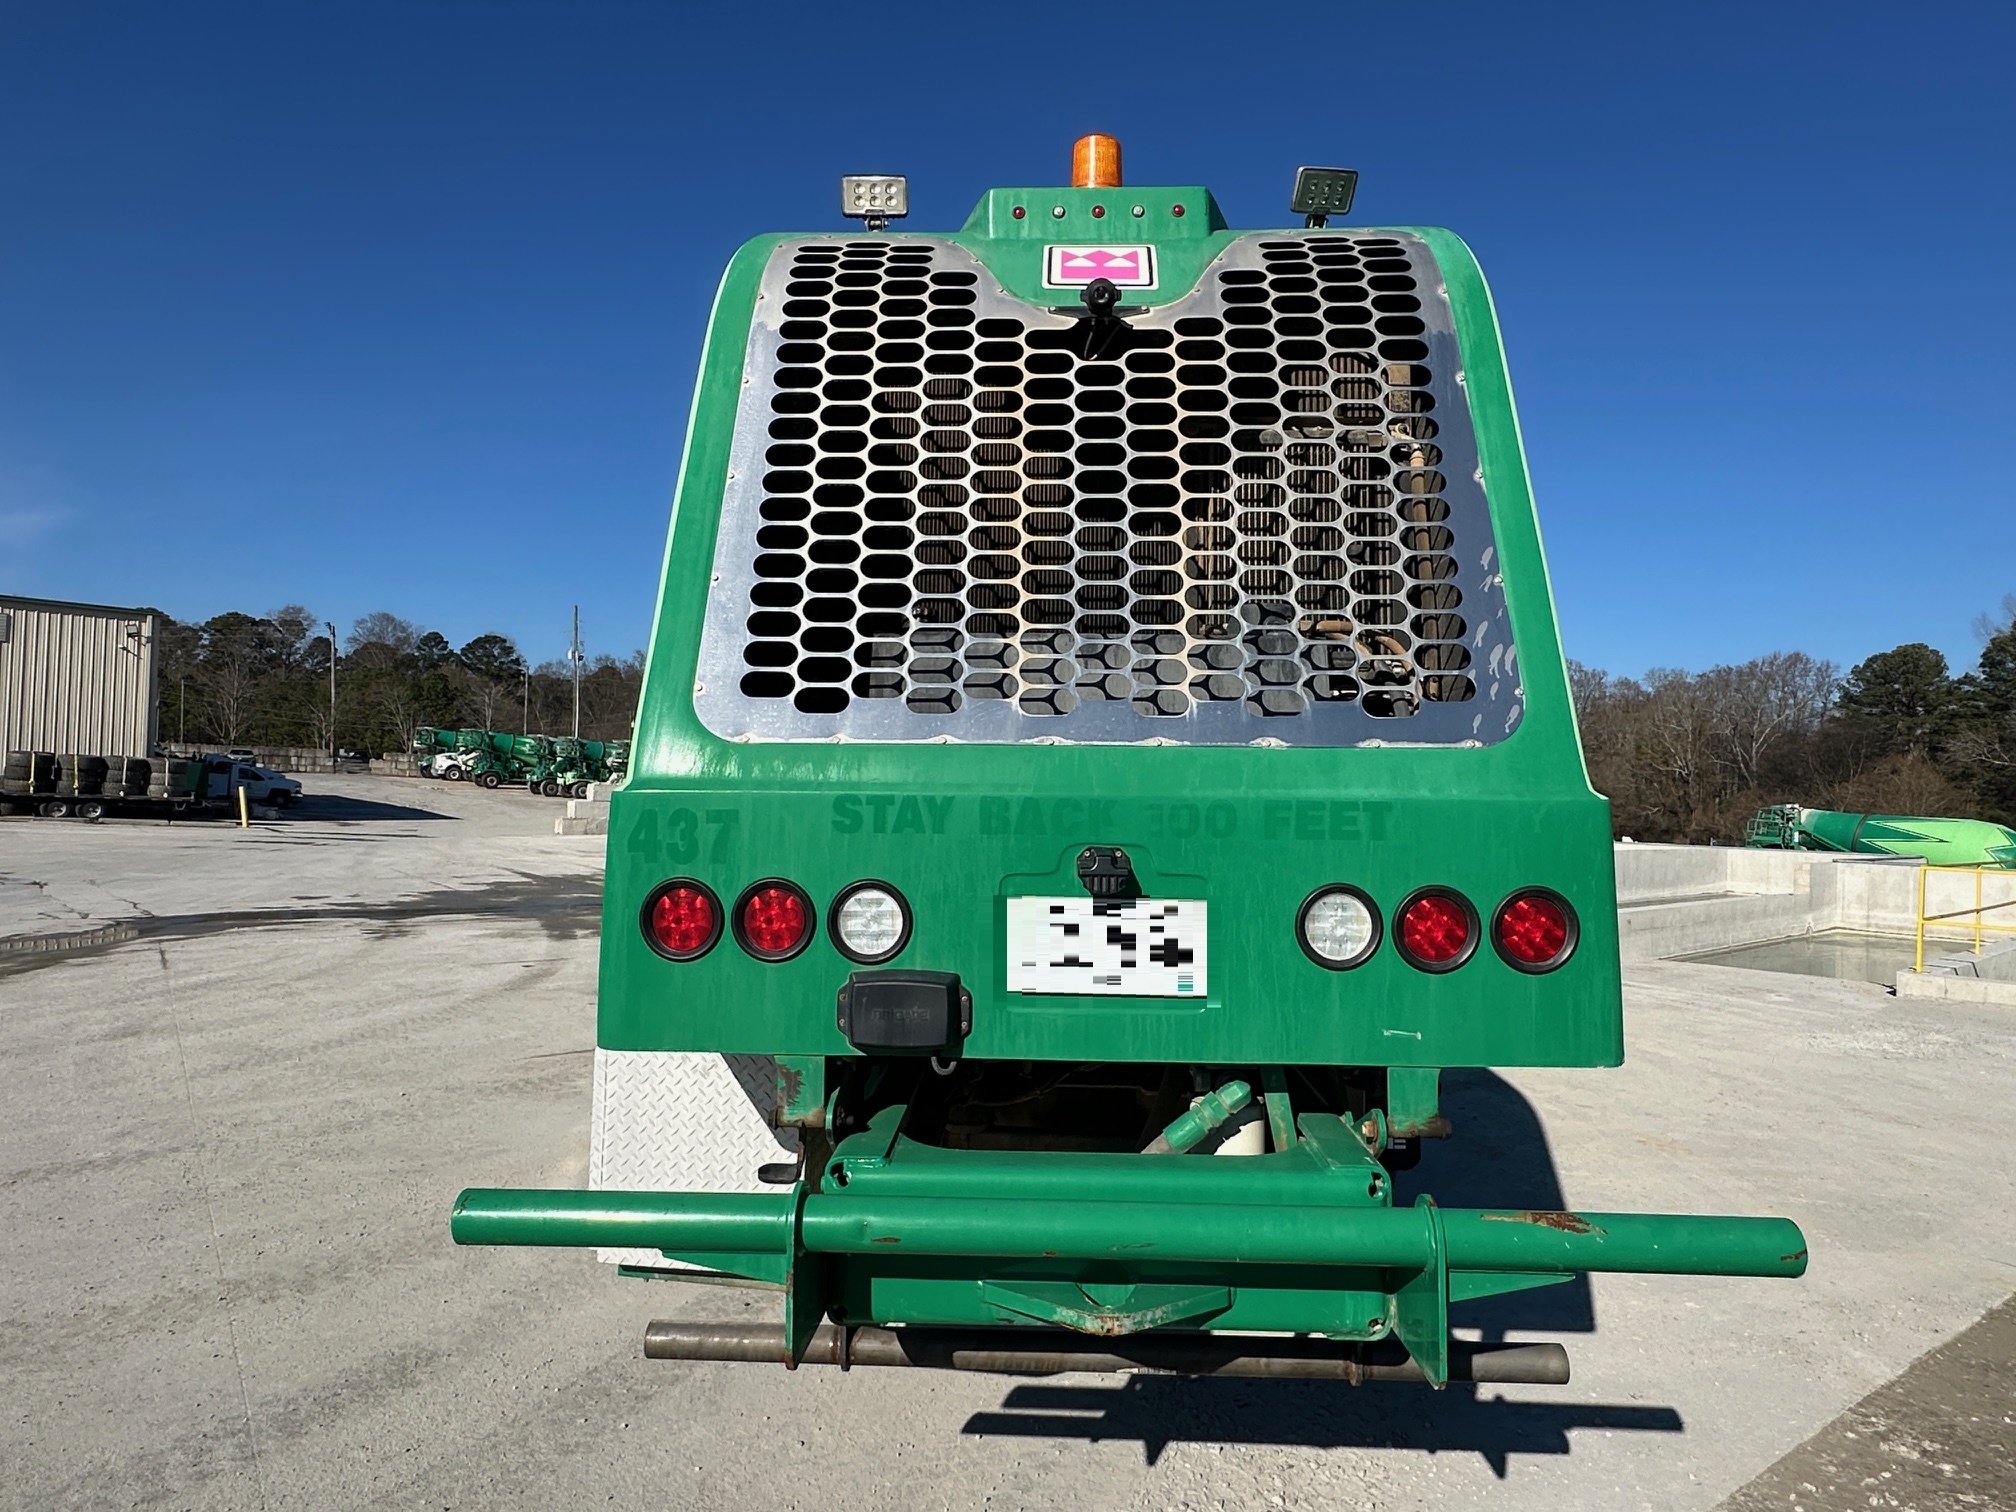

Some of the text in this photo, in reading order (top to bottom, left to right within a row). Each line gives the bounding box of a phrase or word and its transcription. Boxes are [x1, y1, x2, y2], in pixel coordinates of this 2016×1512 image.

[627, 808, 740, 866] 437
[832, 794, 955, 834] STAY
[979, 795, 1119, 836] BACK
[1265, 800, 1393, 841] FEET
